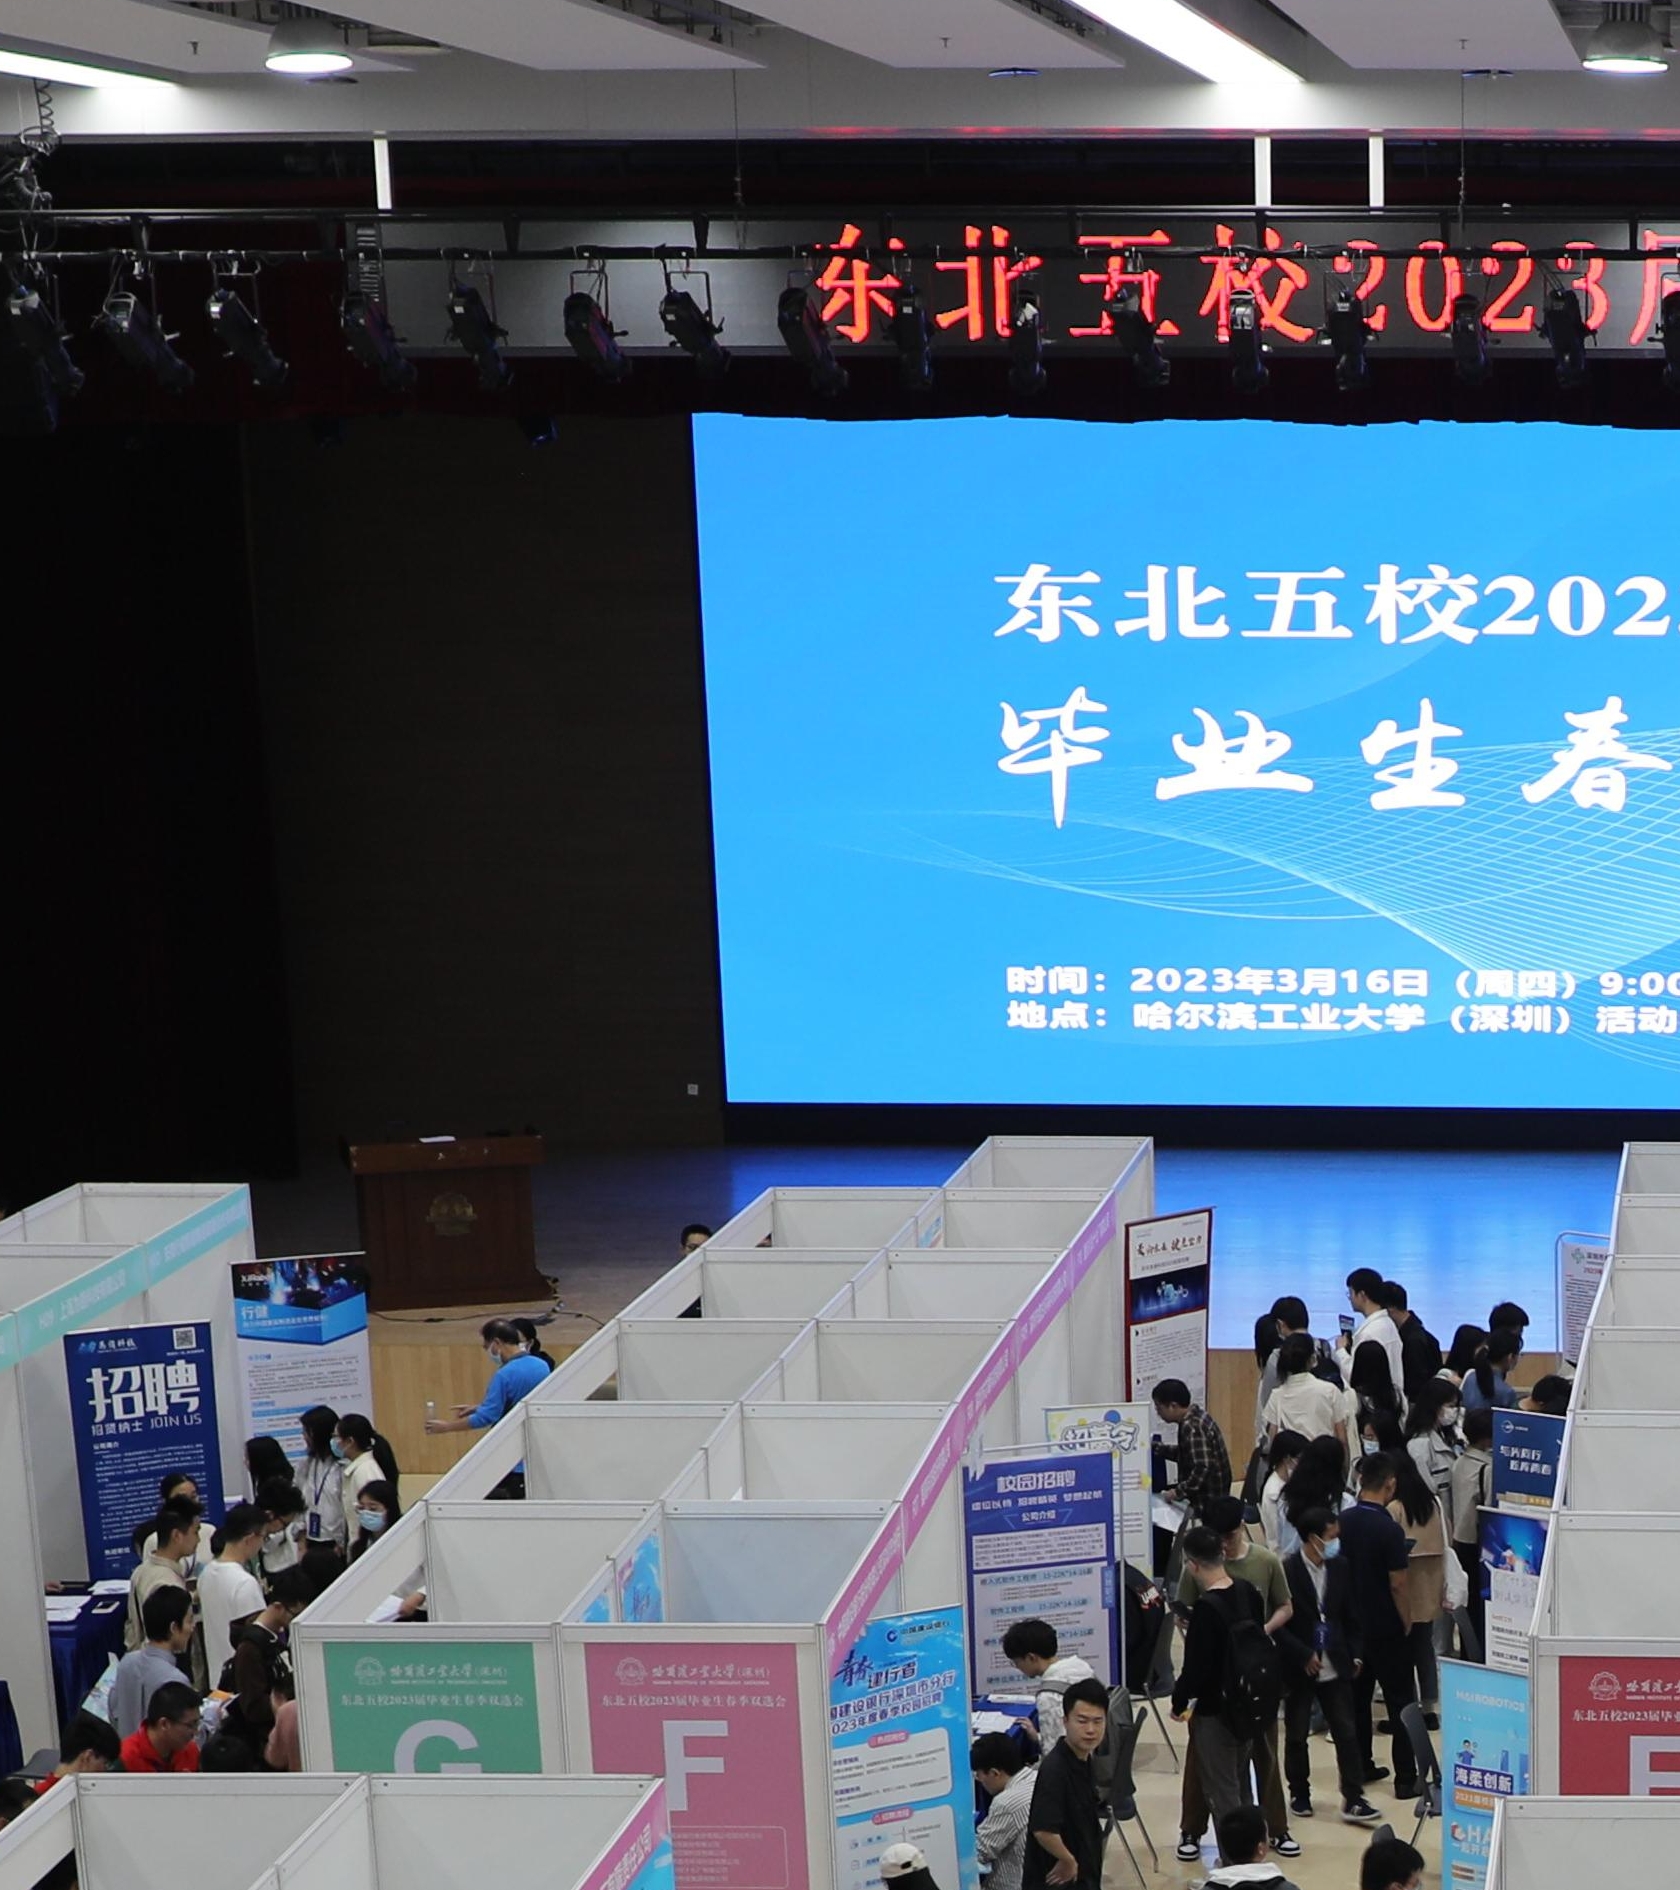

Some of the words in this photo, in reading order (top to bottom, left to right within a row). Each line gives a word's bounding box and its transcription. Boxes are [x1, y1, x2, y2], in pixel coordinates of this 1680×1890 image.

[85, 1359, 201, 1423] 招聘
[149, 1415, 180, 1430] JOIN
[183, 1412, 203, 1427] US
[996, 1469, 1076, 1494] 校园招聘
[831, 1692, 942, 1737] 023年度春季校园招聘
[661, 1719, 729, 1812] F
[1454, 1766, 1514, 1793] 海柔创新
